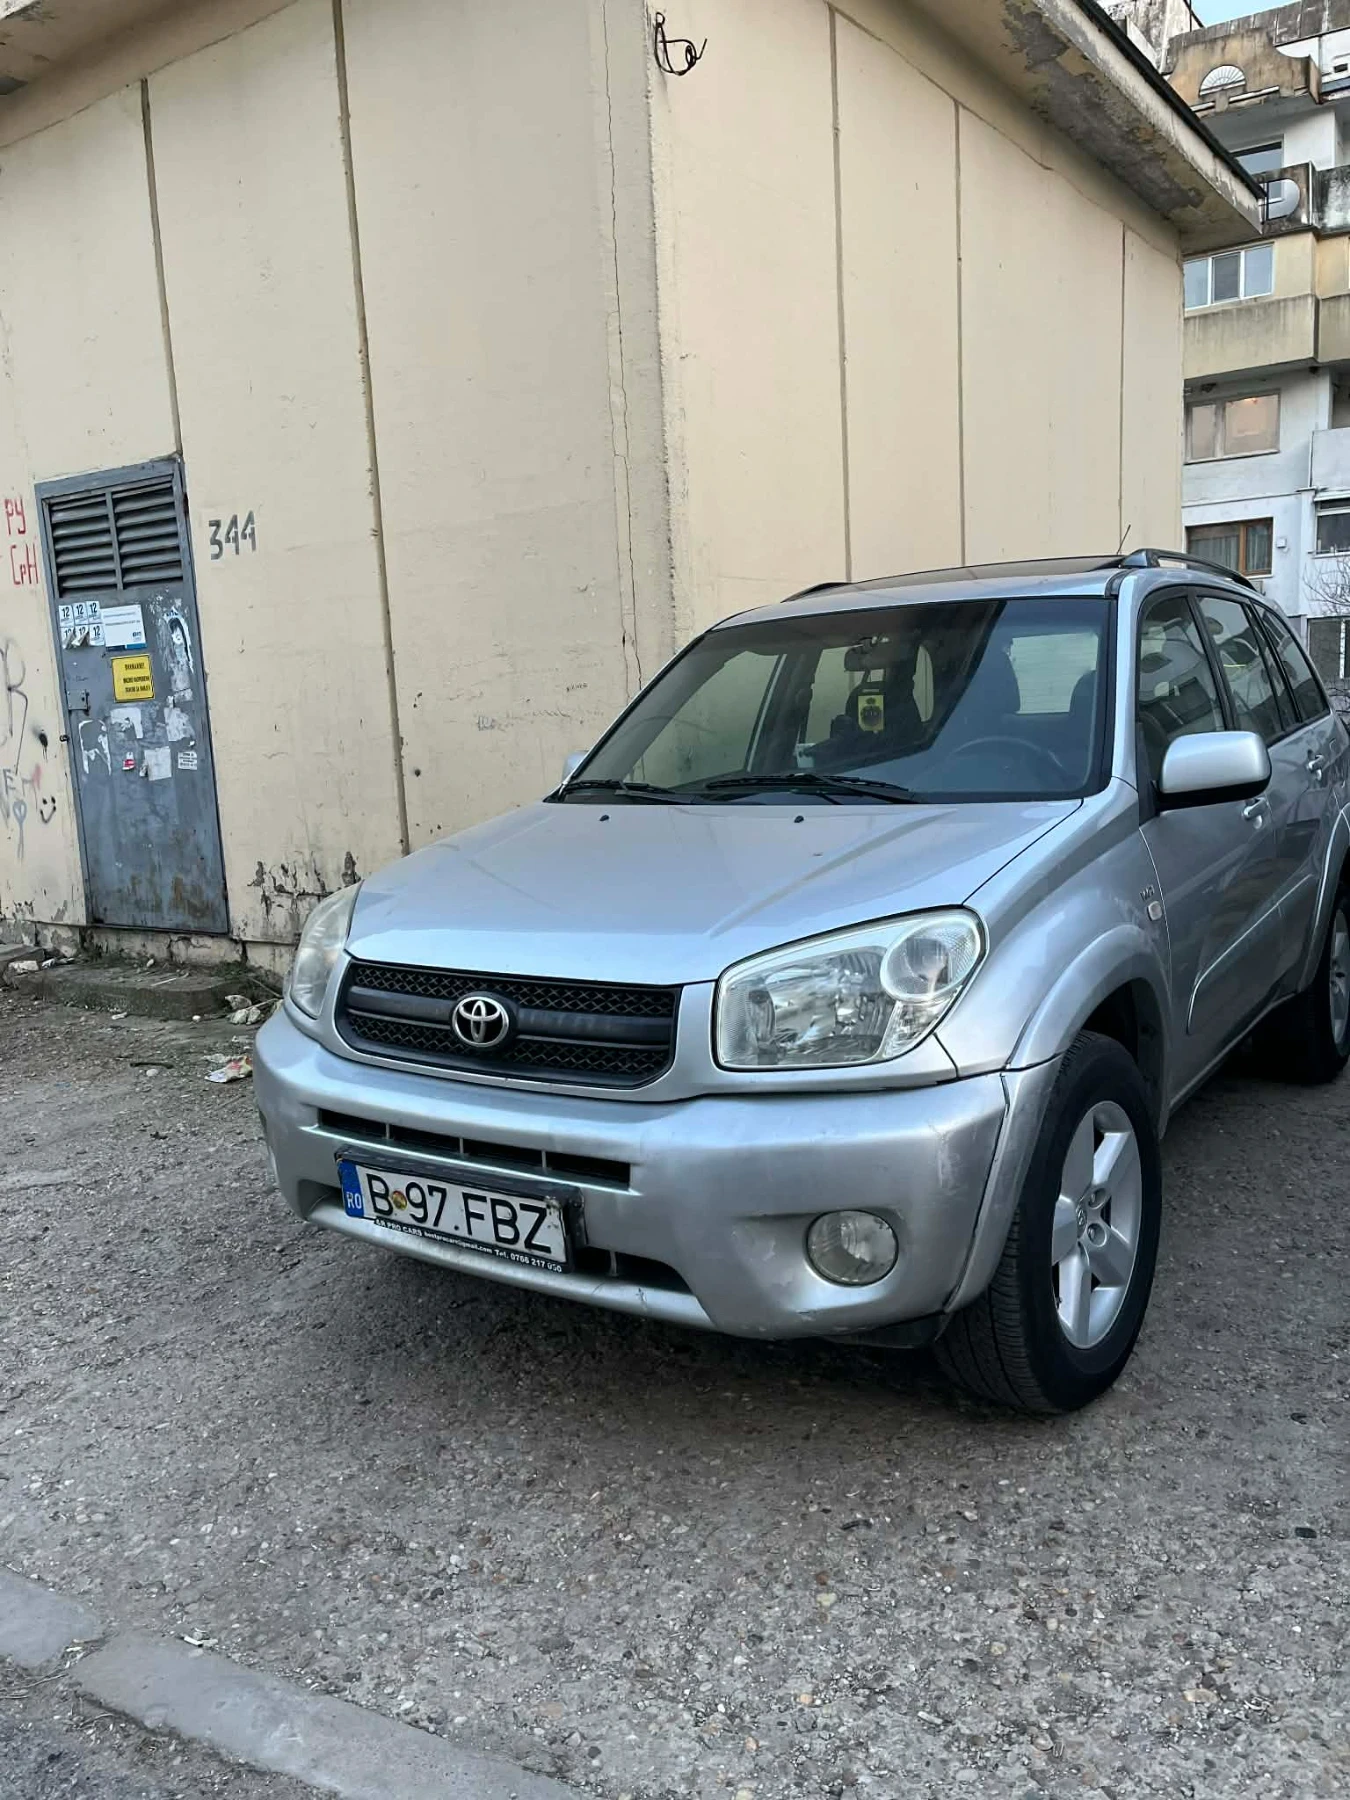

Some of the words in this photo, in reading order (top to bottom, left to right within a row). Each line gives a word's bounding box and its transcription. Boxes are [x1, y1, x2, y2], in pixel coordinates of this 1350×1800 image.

[208, 509, 256, 560] 344
[62, 606, 70, 618] 12
[76, 604, 84, 615] 12
[89, 602, 98, 613] 12
[93, 625, 101, 637] 12
[346, 1191, 362, 1209] RO
[366, 1173, 394, 1216] B
[405, 1181, 447, 1227] 97
[461, 1191, 552, 1254] FBZ
[494, 1249, 509, 1259] Tel.
[531, 1258, 546, 1268] 217
